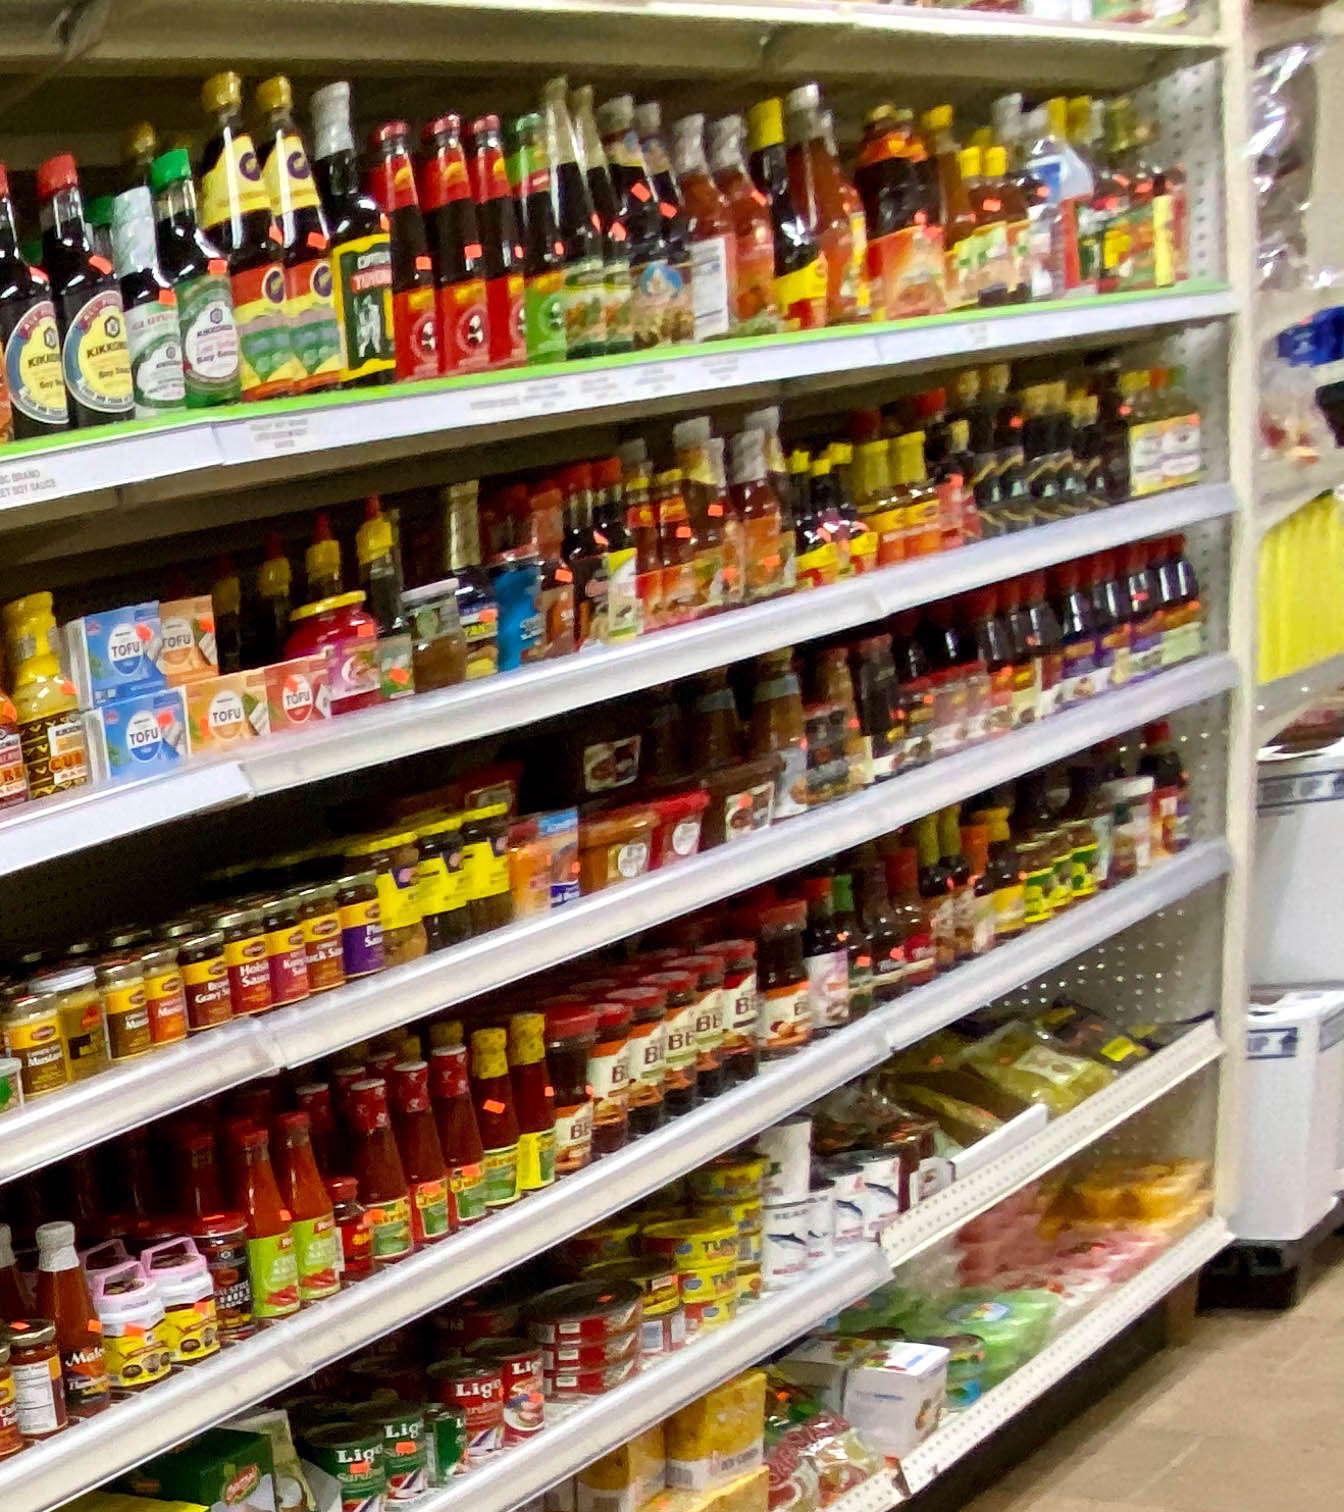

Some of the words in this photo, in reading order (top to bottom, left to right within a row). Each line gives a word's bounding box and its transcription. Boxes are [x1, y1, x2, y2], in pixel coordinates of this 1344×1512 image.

[112, 640, 141, 658] TOFU
[212, 706, 242, 722] TOFU
[128, 726, 159, 744] TOFU
[27, 1051, 63, 1067] Mustar
